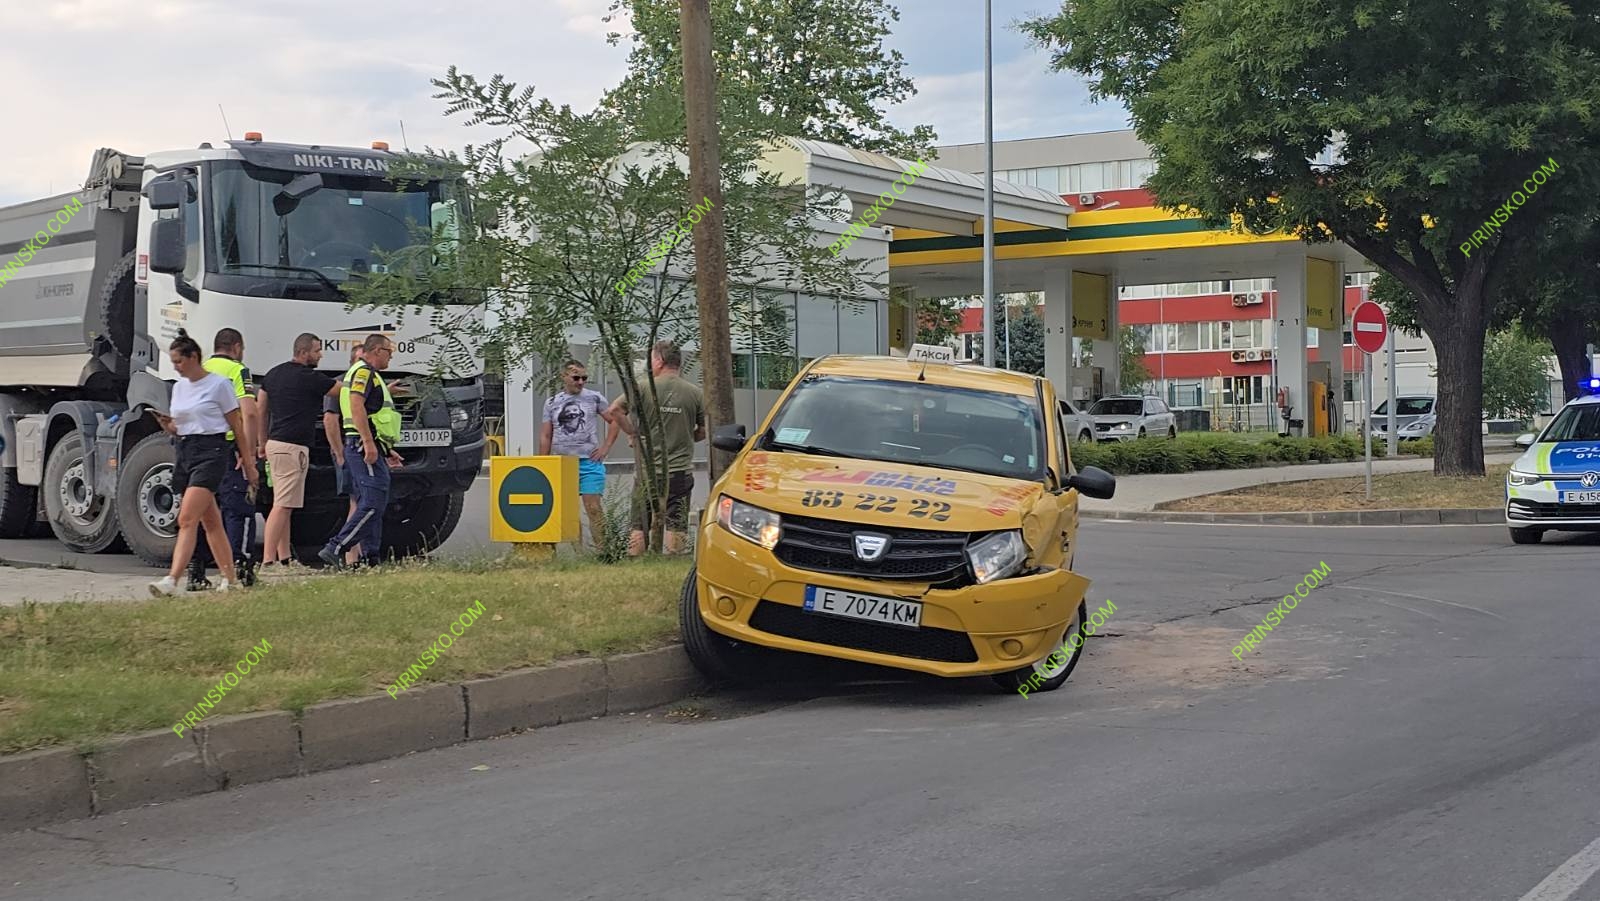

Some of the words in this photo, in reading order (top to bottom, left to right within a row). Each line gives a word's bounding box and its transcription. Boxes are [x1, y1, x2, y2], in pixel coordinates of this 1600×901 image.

[915, 350, 950, 361] ТАКСИ
[412, 431, 435, 442] 0110
[437, 431, 450, 441] XP
[1568, 493, 1575, 501] E
[801, 489, 844, 508] 83
[854, 493, 898, 513] 22
[906, 498, 951, 522] 22
[822, 592, 836, 611] E
[844, 595, 889, 620] 7074
[892, 602, 918, 624] KM
